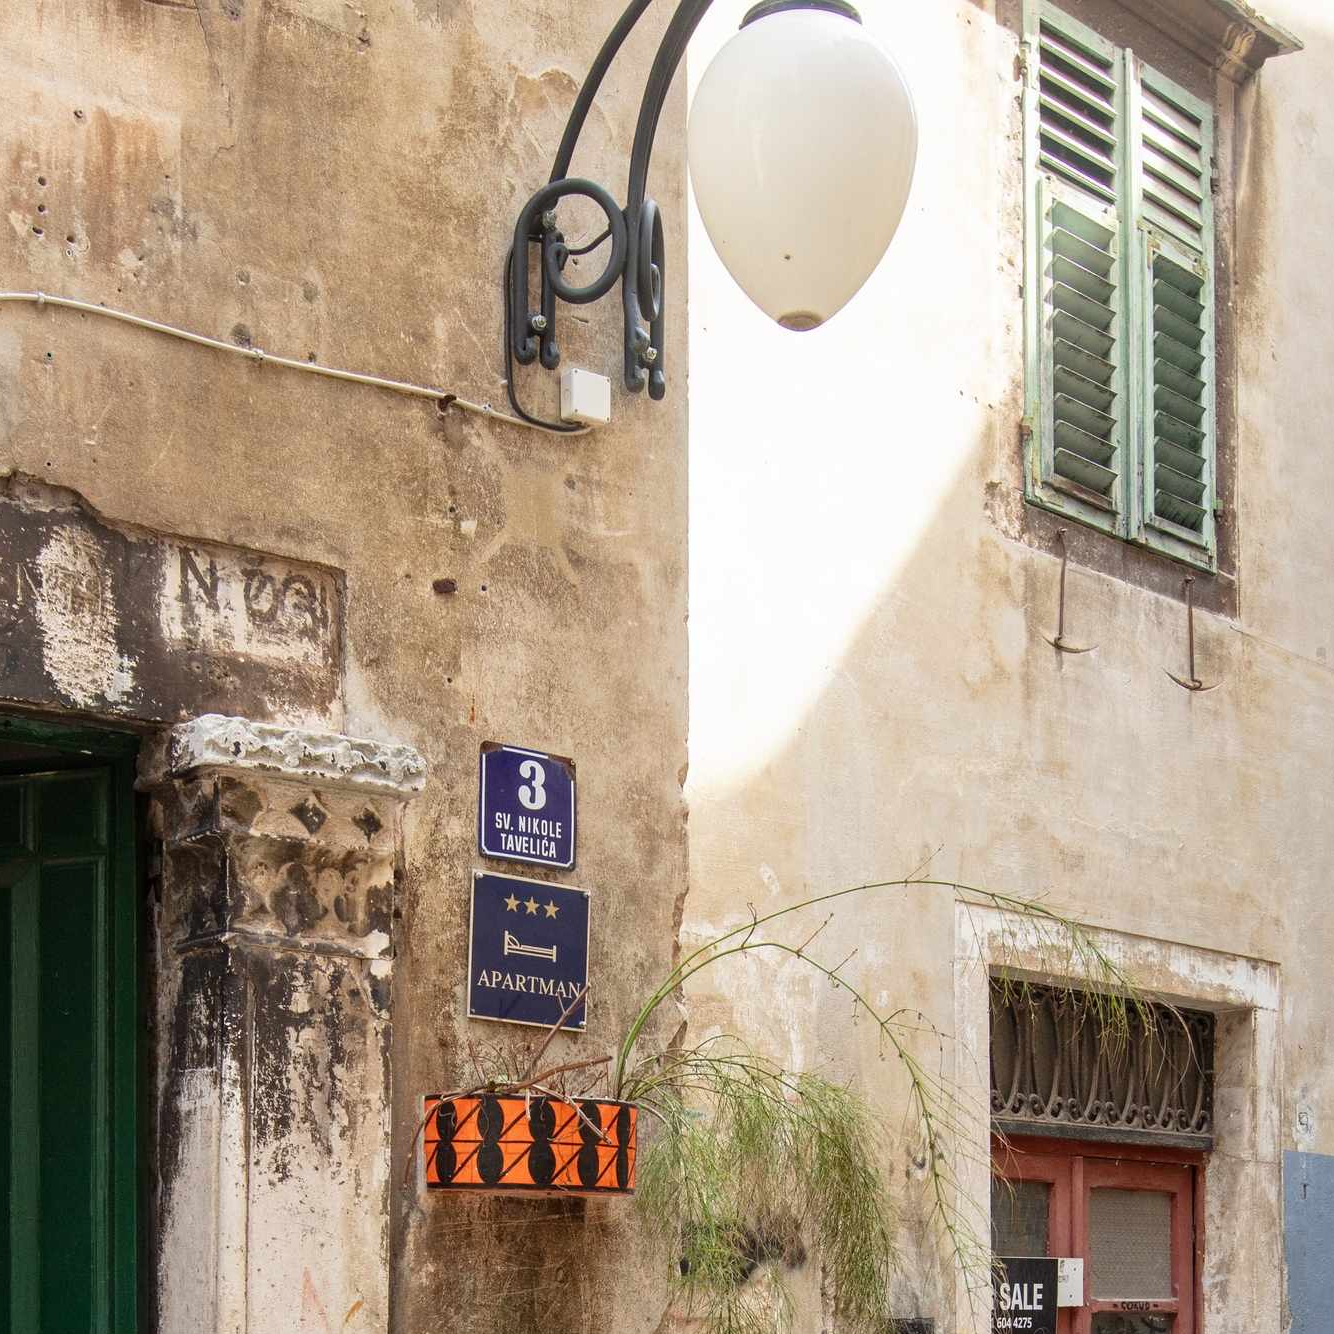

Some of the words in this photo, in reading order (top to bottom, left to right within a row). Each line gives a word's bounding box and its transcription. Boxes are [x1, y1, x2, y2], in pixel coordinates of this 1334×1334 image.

[518, 760, 547, 811] 3
[495, 813, 514, 831] SV.
[518, 816, 562, 839] NIKOLE
[500, 833, 557, 859] TAVELIĆA
[477, 969, 582, 999] APARTMAN
[999, 1283, 1043, 1310] SALE
[997, 1317, 1011, 1328] 604
[1013, 1317, 1032, 1328] 4275
